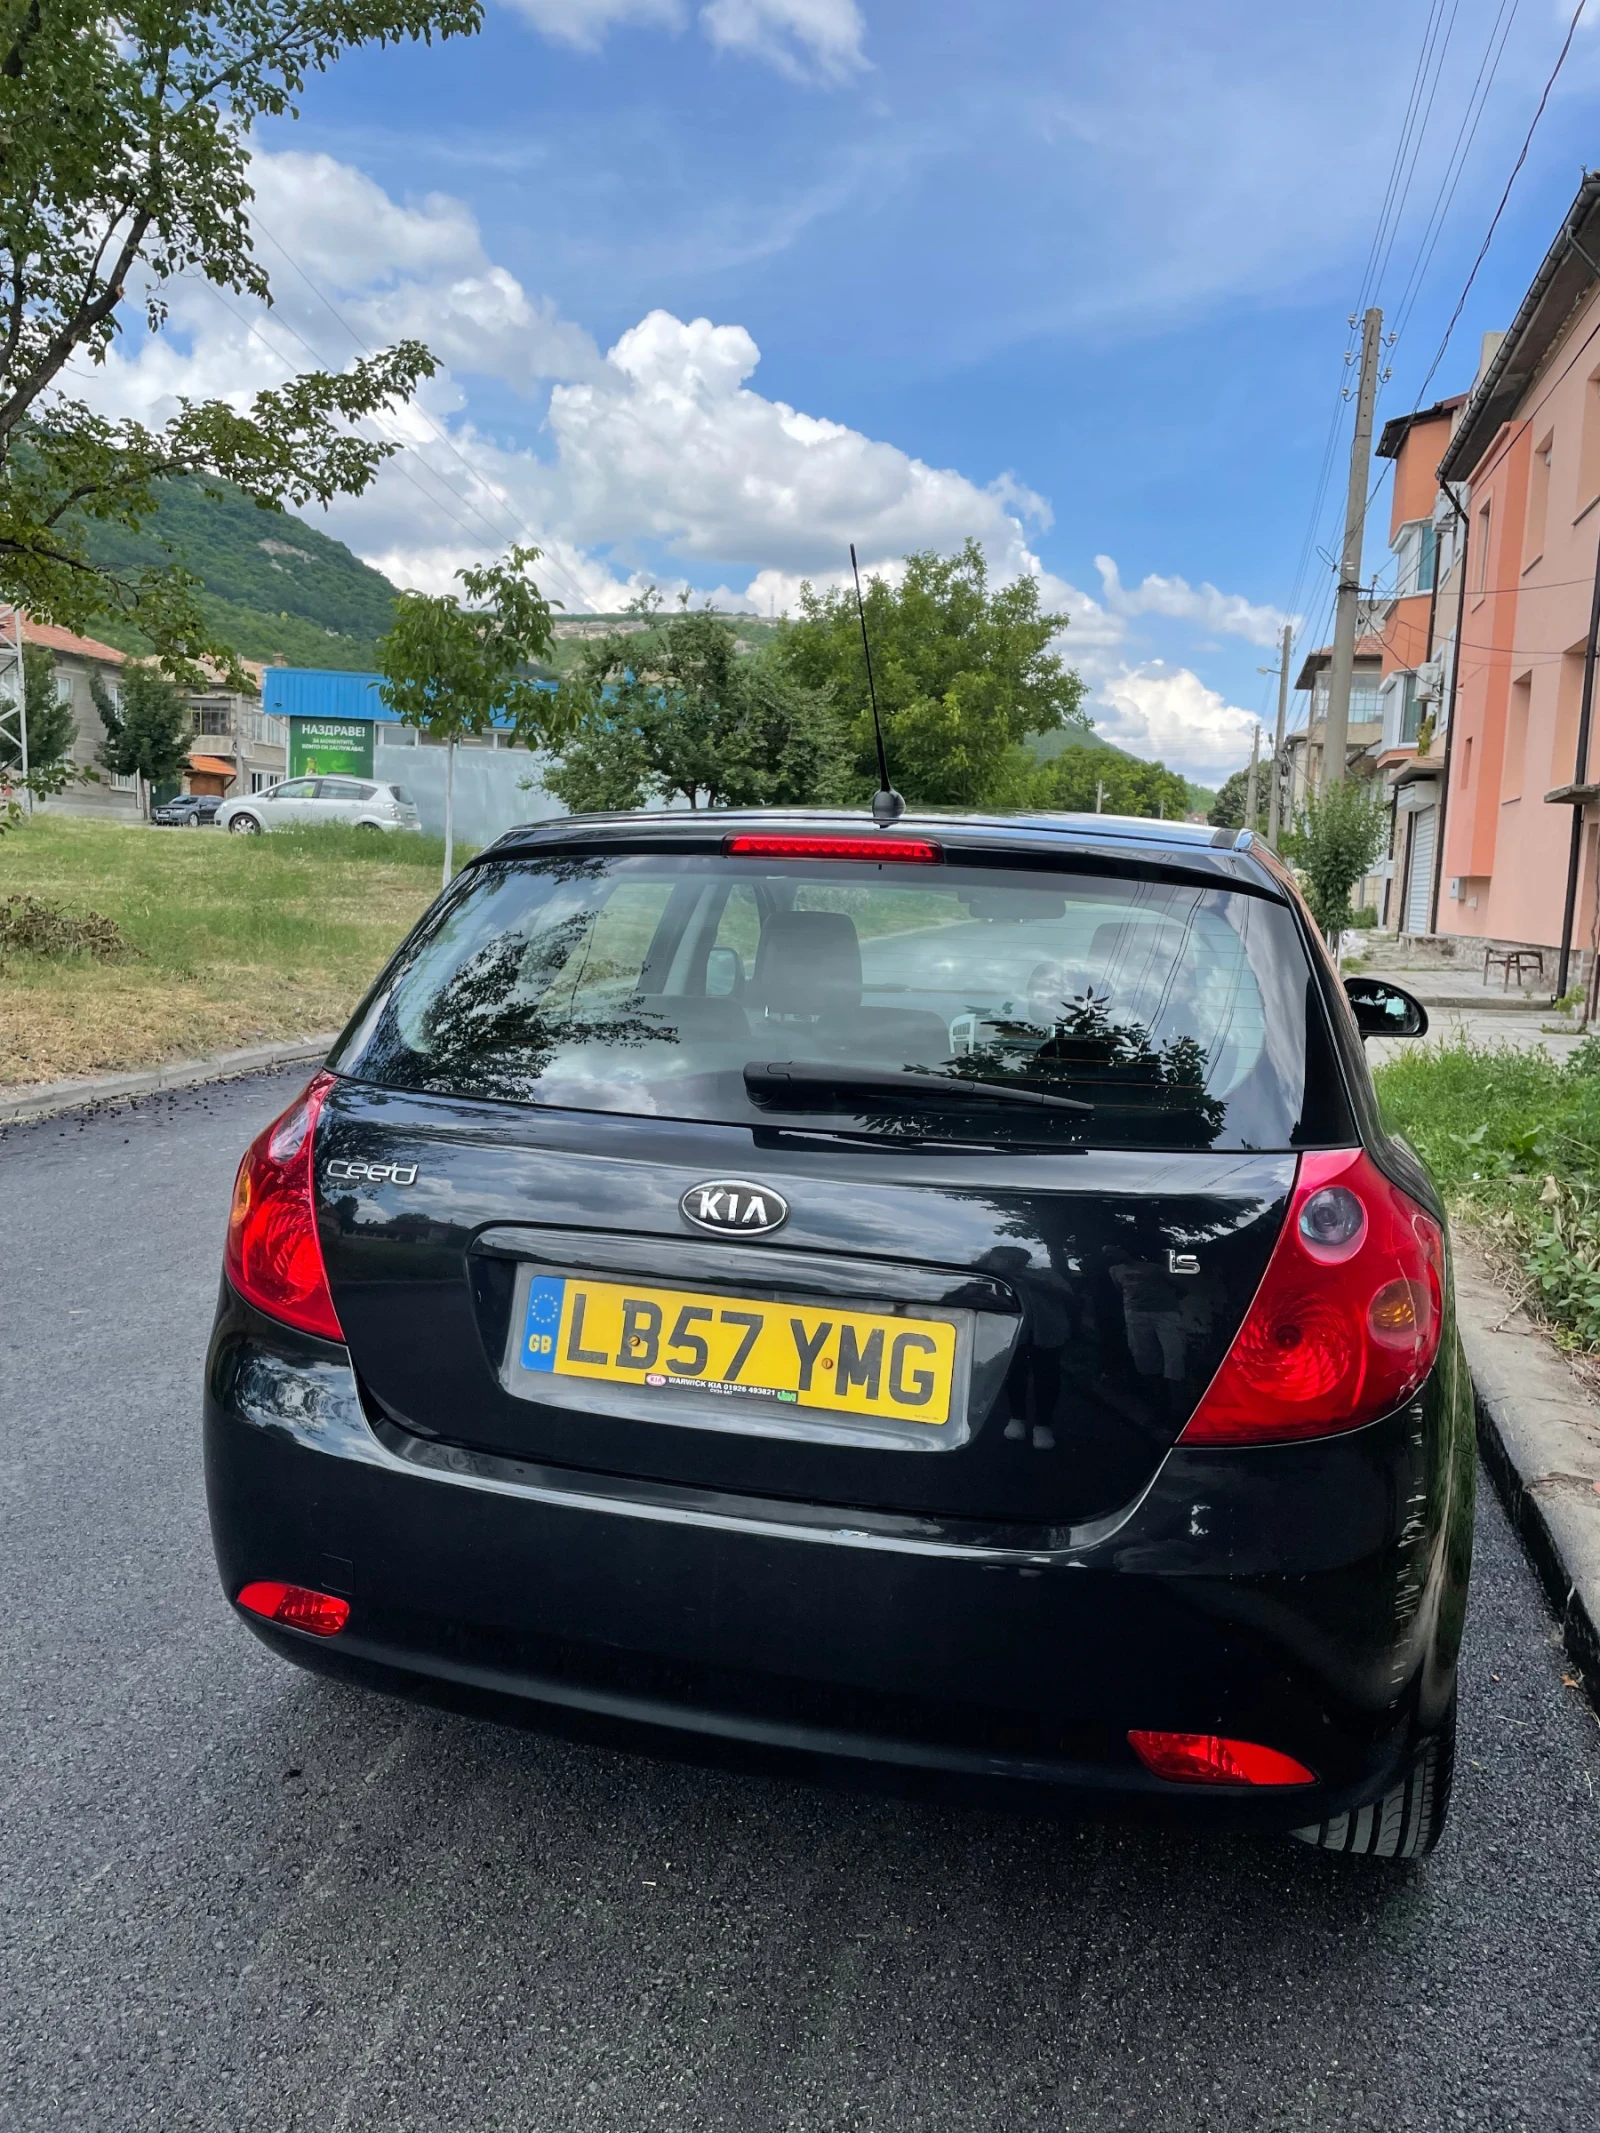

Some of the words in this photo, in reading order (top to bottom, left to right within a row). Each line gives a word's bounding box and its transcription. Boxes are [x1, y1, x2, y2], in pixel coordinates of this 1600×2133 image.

[302, 724, 365, 737] НАЗДРАВЕ!
[699, 1191, 769, 1225] KIA
[528, 1334, 552, 1354] GB
[566, 1293, 764, 1380] LB57
[790, 1318, 938, 1406] YMG
[668, 1376, 706, 1387] WARWICK
[708, 1381, 722, 1389] KIA
[723, 1383, 747, 1392] 01926
[748, 1387, 775, 1396] 493821
